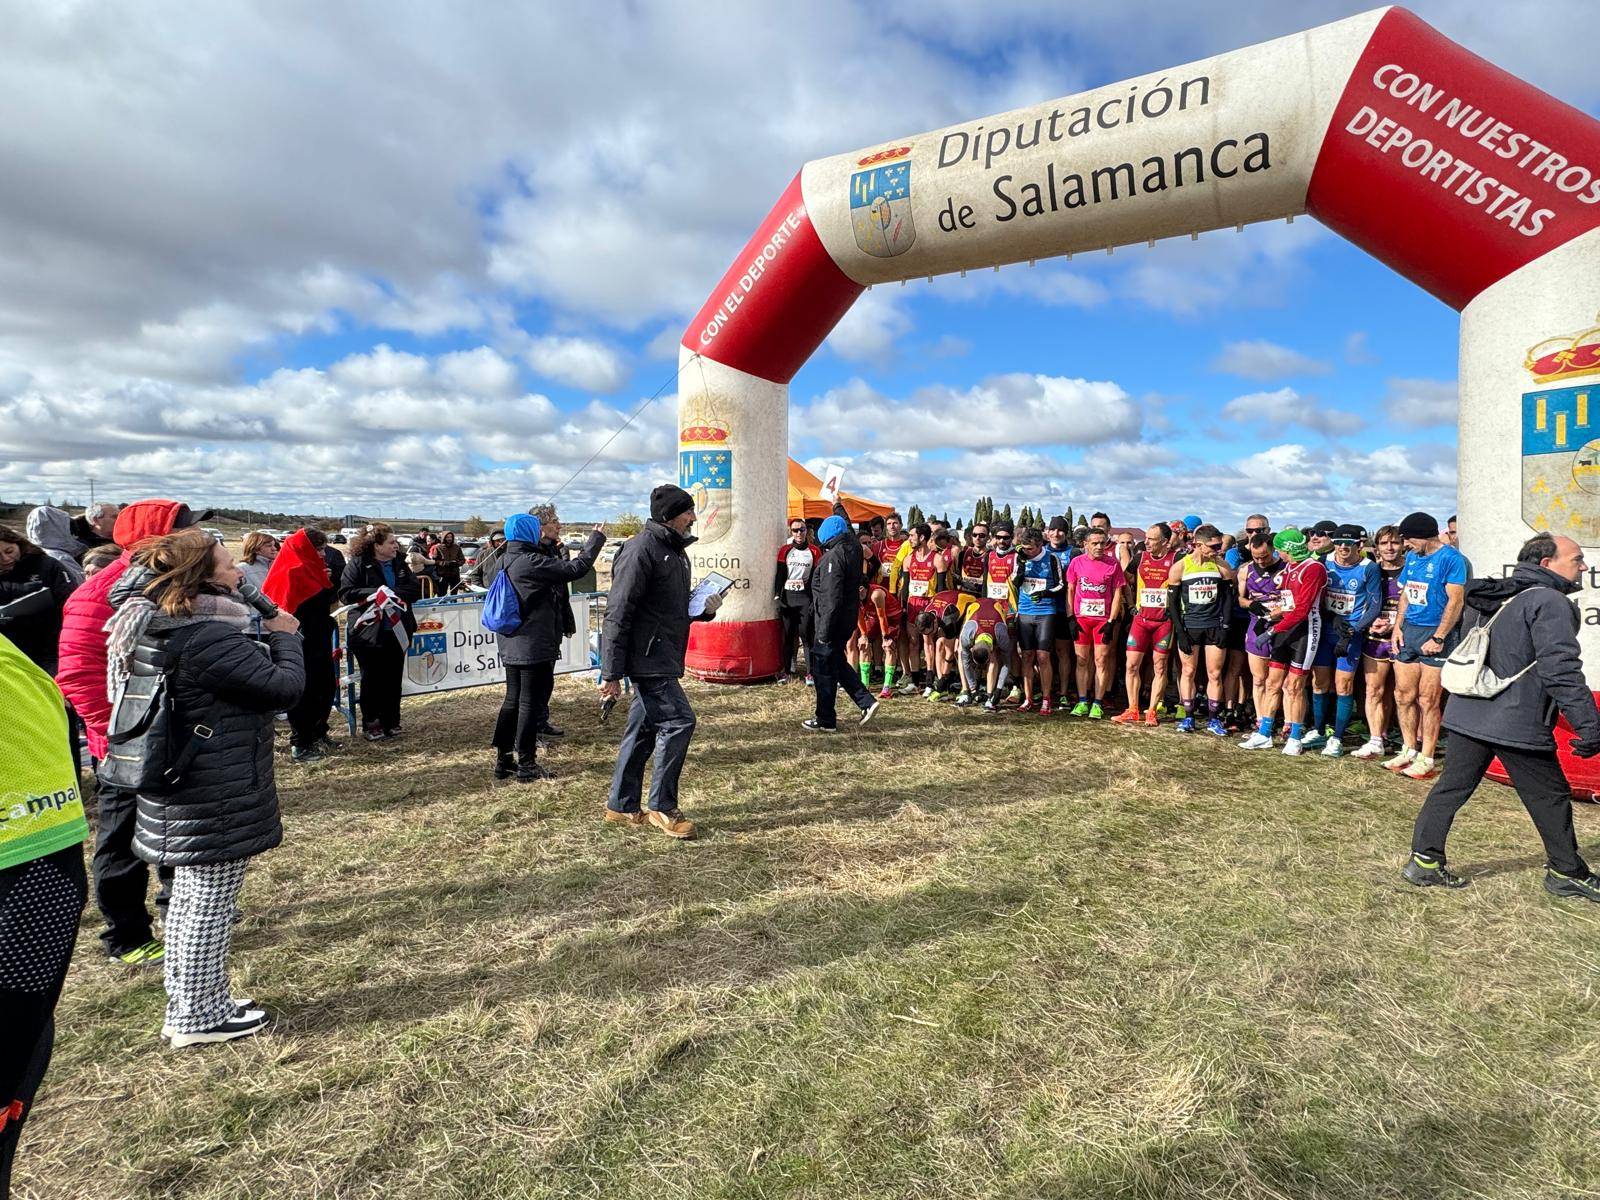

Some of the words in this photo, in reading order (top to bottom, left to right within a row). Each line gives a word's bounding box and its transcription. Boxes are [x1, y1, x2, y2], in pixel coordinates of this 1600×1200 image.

[937, 76, 1210, 169] Diputación
[1373, 63, 1445, 113] CON
[1434, 97, 1600, 204] NUESTROS
[1345, 105, 1556, 237] DEPORTISTAS
[938, 197, 976, 233] de
[993, 132, 1272, 222] Salamanca
[700, 309, 729, 346] CON
[724, 291, 745, 314] EL
[739, 212, 801, 293] DEPORTE
[826, 475, 837, 494] 4
[693, 553, 740, 569] tación
[1145, 594, 1162, 604] 186
[1194, 591, 1213, 600] 170
[1408, 588, 1419, 599] 13
[1086, 605, 1099, 613] 24
[1330, 601, 1345, 611] 43
[454, 661, 471, 674] de
